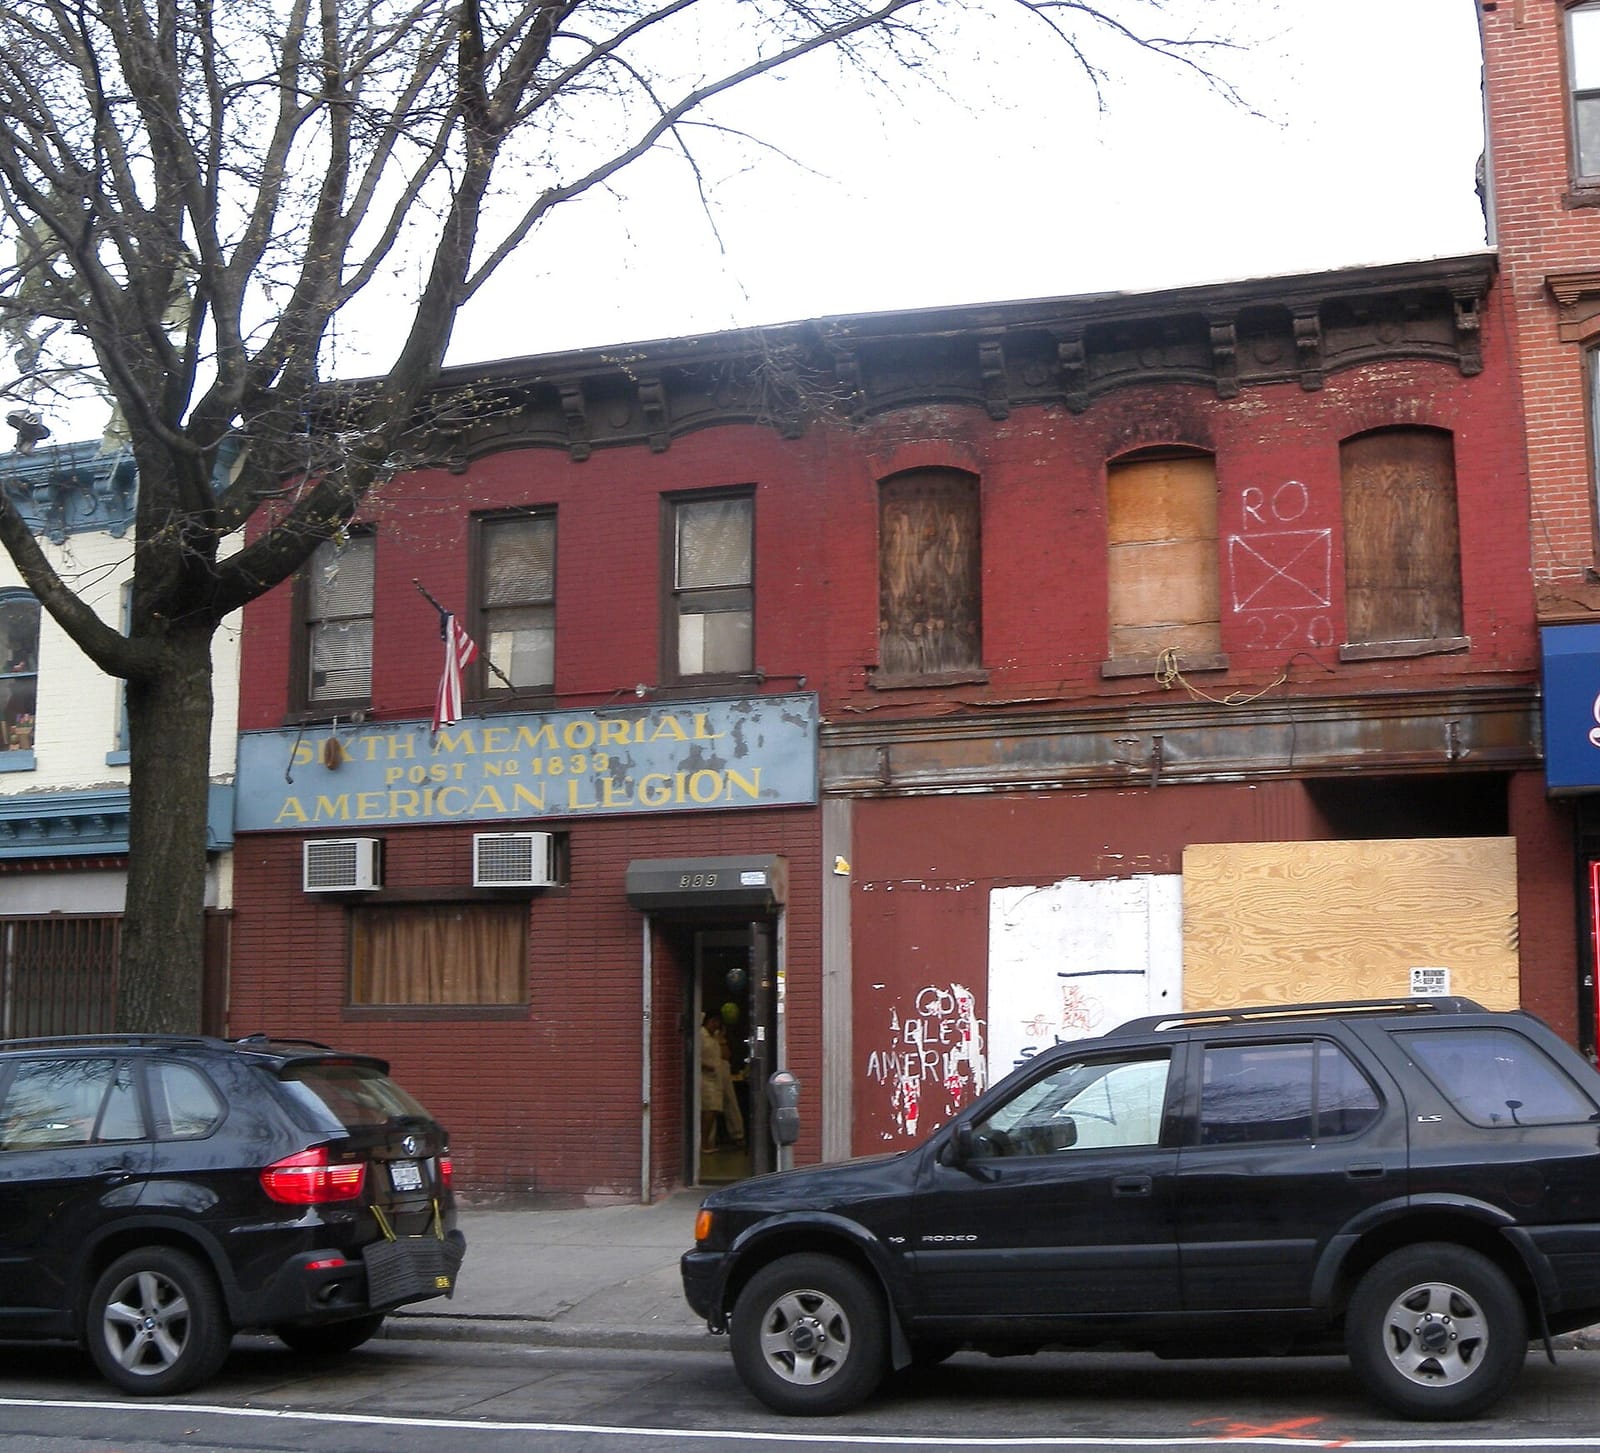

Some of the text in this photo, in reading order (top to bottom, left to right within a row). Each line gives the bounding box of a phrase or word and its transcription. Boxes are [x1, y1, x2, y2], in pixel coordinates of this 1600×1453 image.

[290, 712, 726, 765] SIXTH MEMORIAL
[385, 762, 468, 785] POST
[532, 752, 610, 777] 1833
[274, 767, 762, 824] AMERICAN LEGION
[921, 1234, 978, 1242] RODEO
